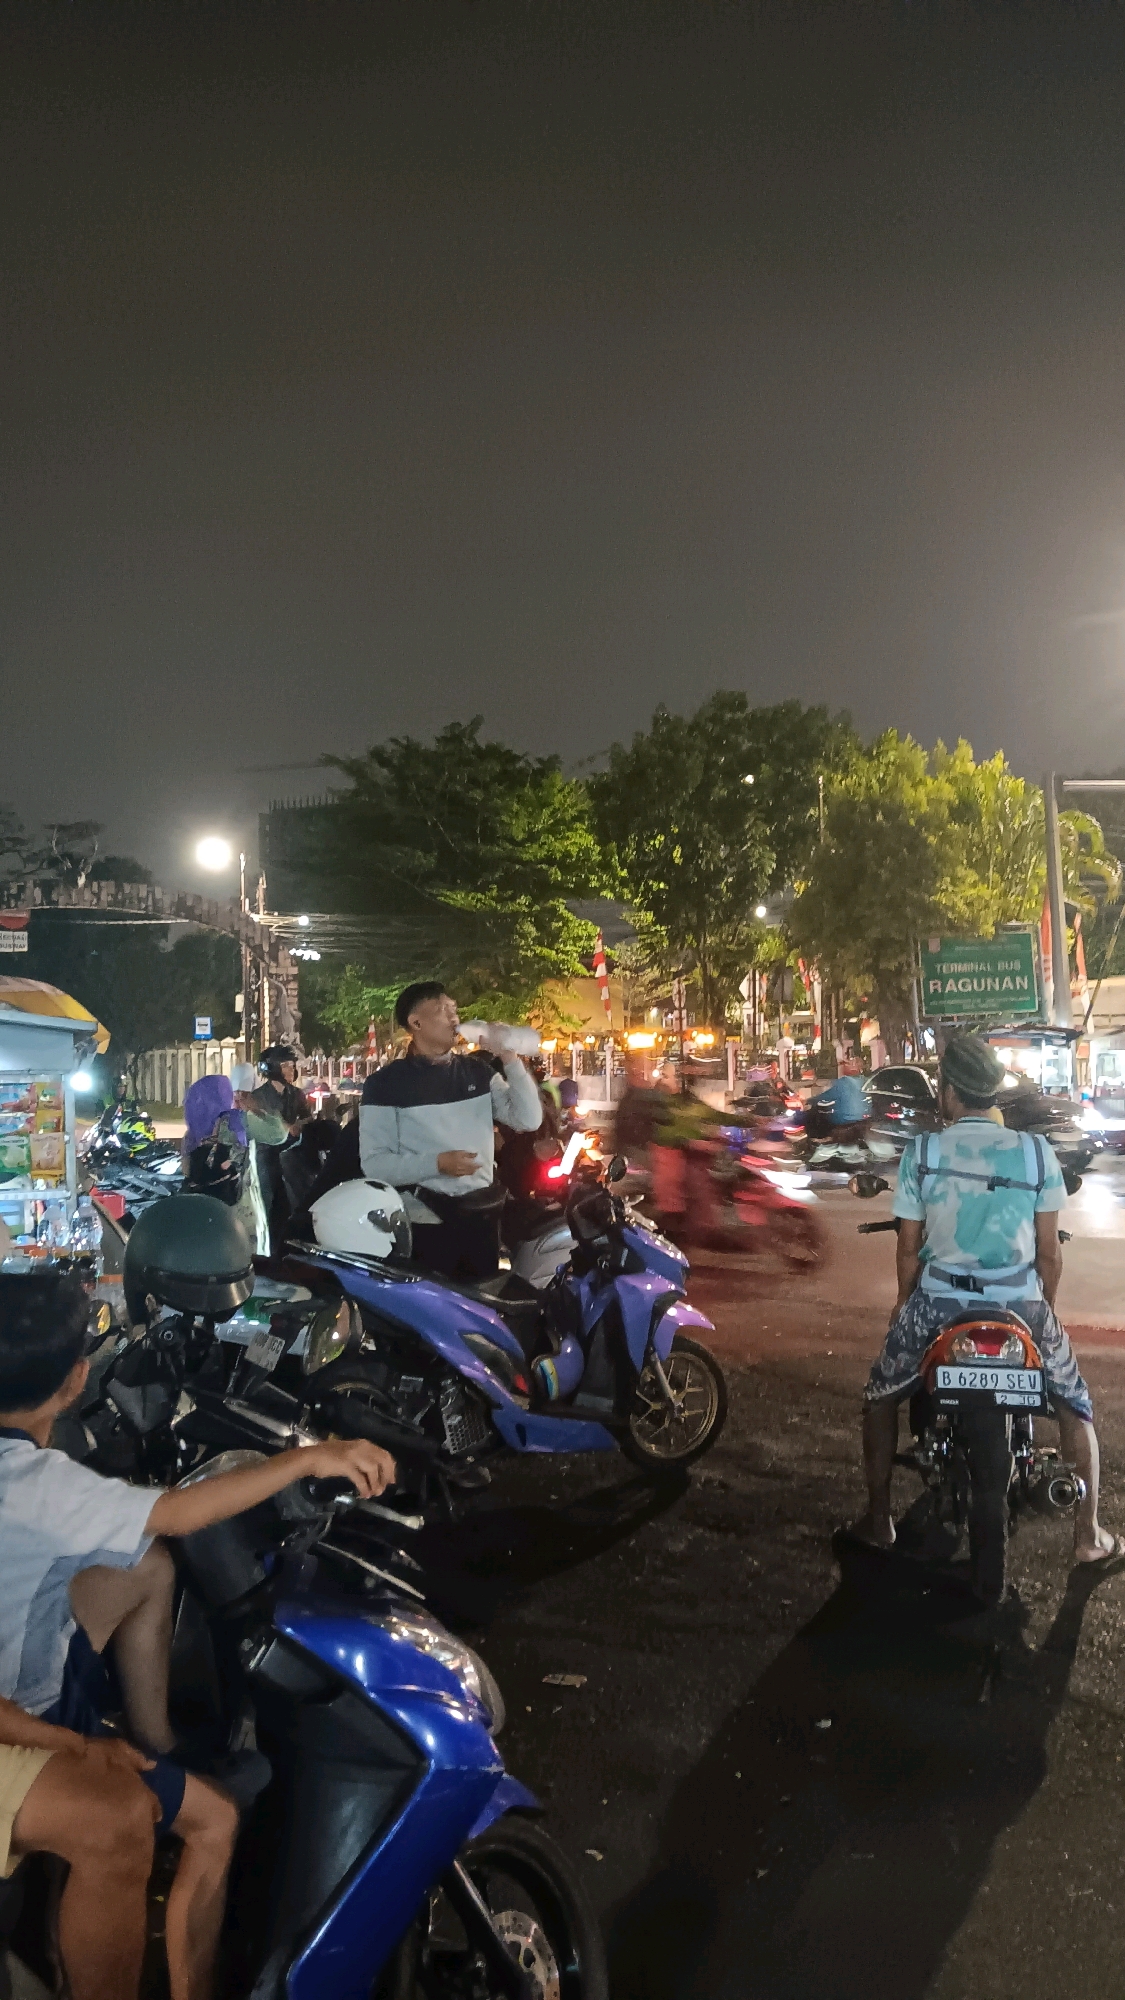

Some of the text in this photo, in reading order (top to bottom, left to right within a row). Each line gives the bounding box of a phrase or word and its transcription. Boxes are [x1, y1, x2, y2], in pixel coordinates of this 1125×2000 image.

[935, 959, 1021, 975] TERMINAL BUS
[929, 975, 1028, 994] RAGUNAN
[942, 1371, 1037, 1390] B 6289 SEV
